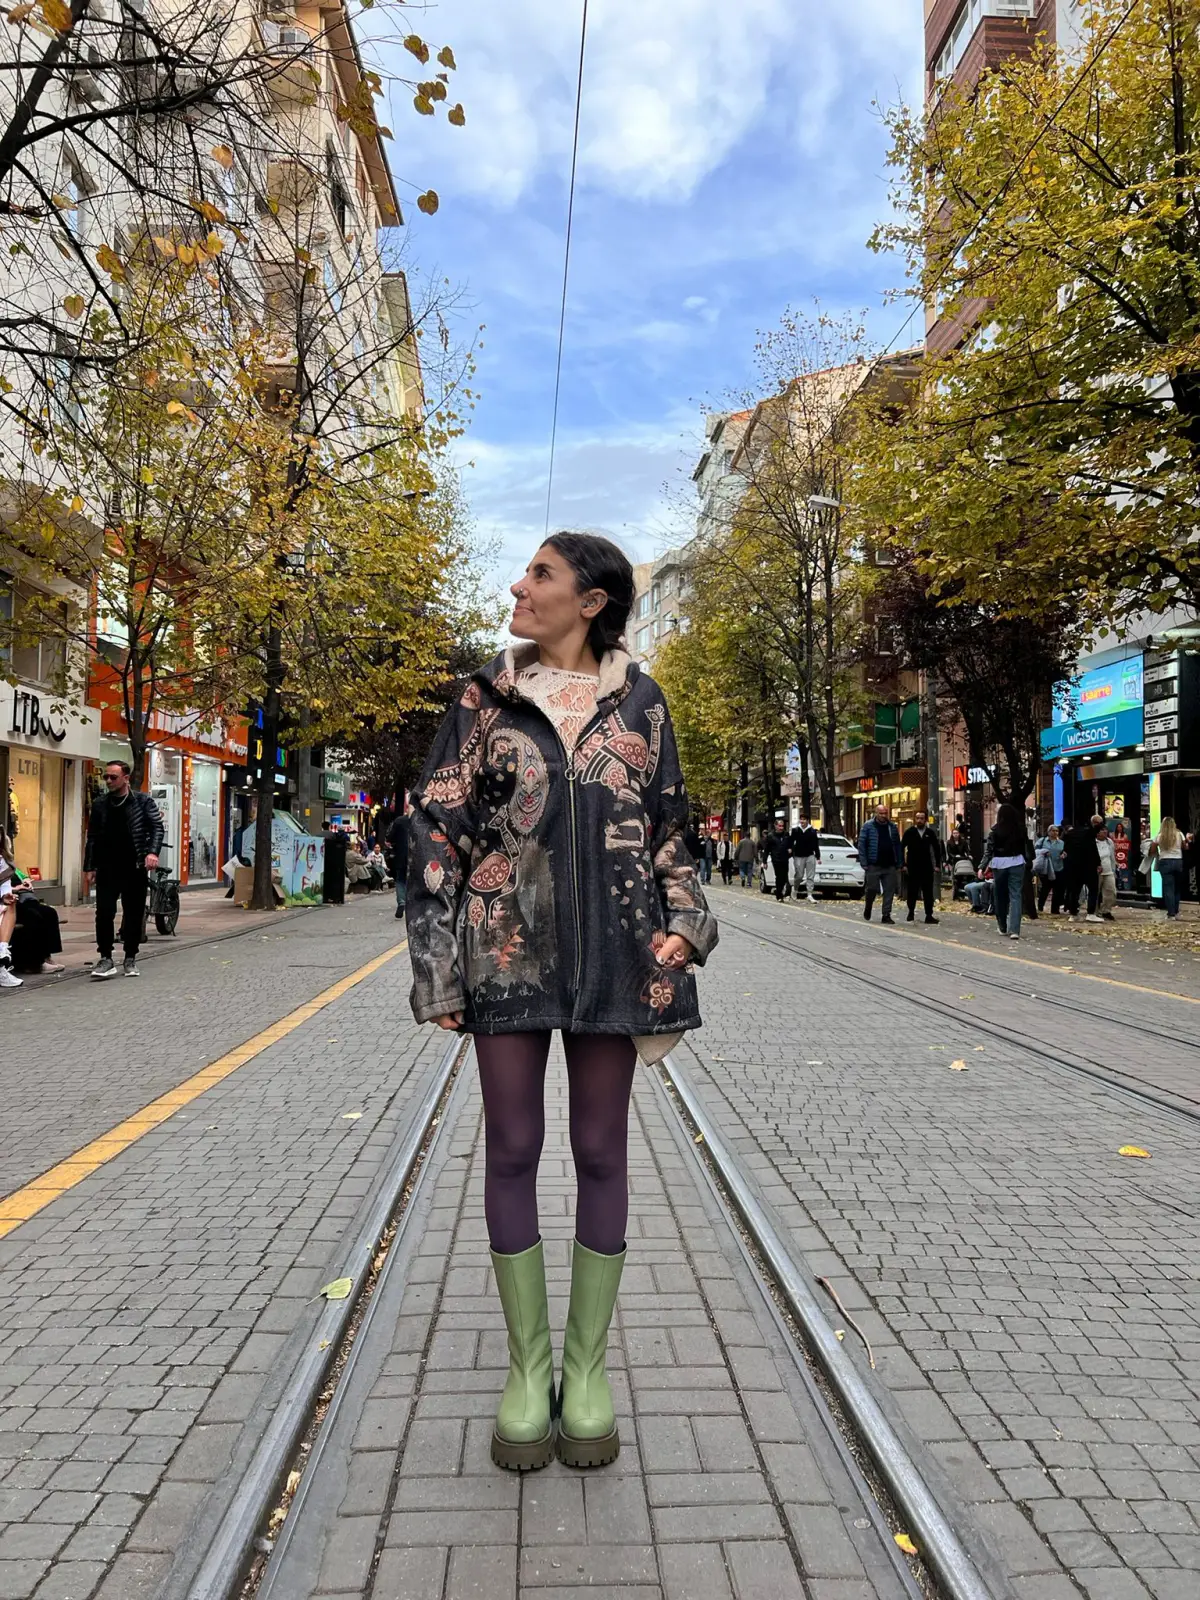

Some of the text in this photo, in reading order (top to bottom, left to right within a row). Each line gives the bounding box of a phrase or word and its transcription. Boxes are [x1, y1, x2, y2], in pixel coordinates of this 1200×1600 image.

[13, 689, 40, 736] LTB
[1067, 726, 1109, 746] watsons
[18, 758, 39, 776] LTB
